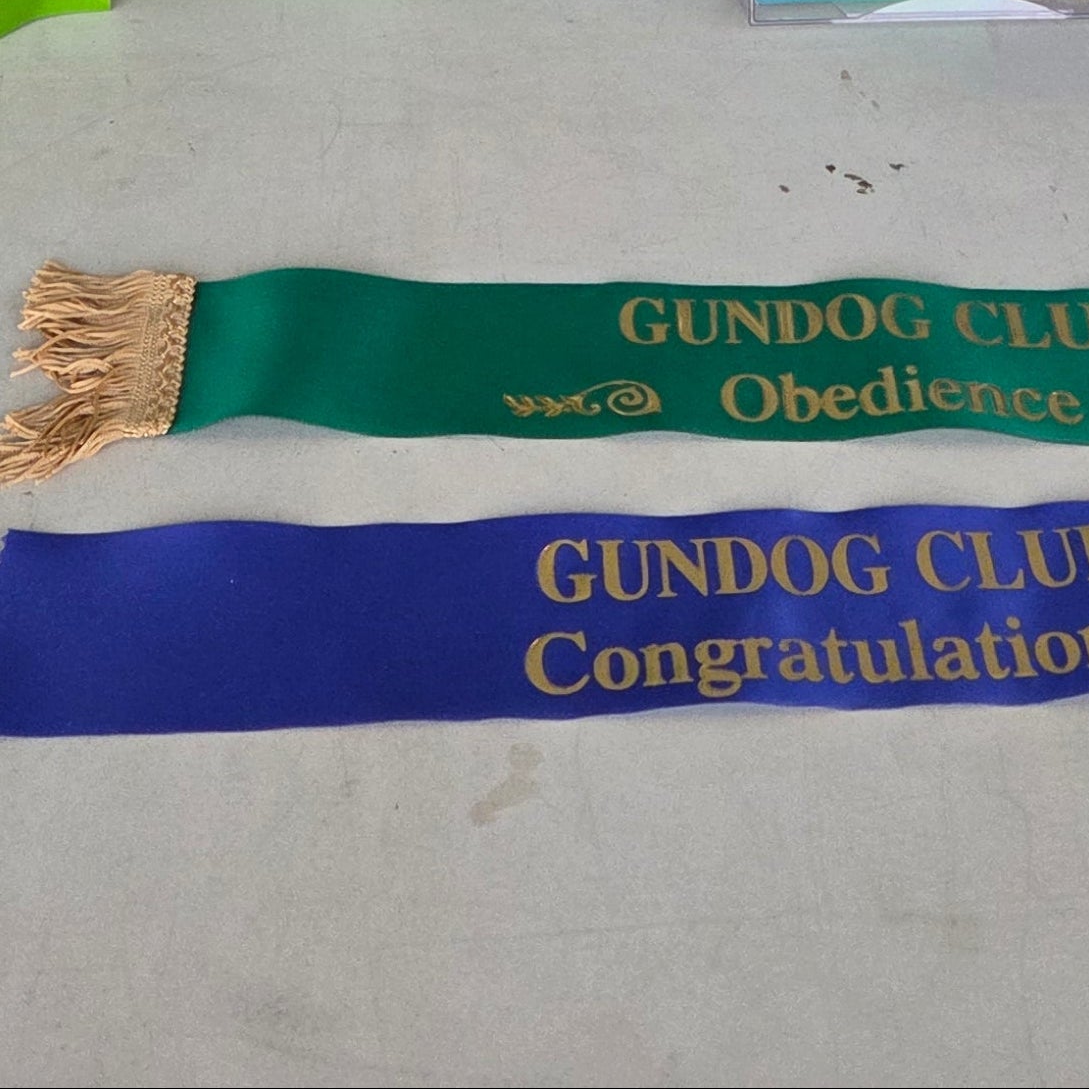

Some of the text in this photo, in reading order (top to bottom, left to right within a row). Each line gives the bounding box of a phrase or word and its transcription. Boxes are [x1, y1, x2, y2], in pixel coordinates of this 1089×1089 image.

[618, 293, 932, 347] GUNDOG
[720, 365, 1085, 425] Obedience
[535, 534, 891, 603] GUNDOG
